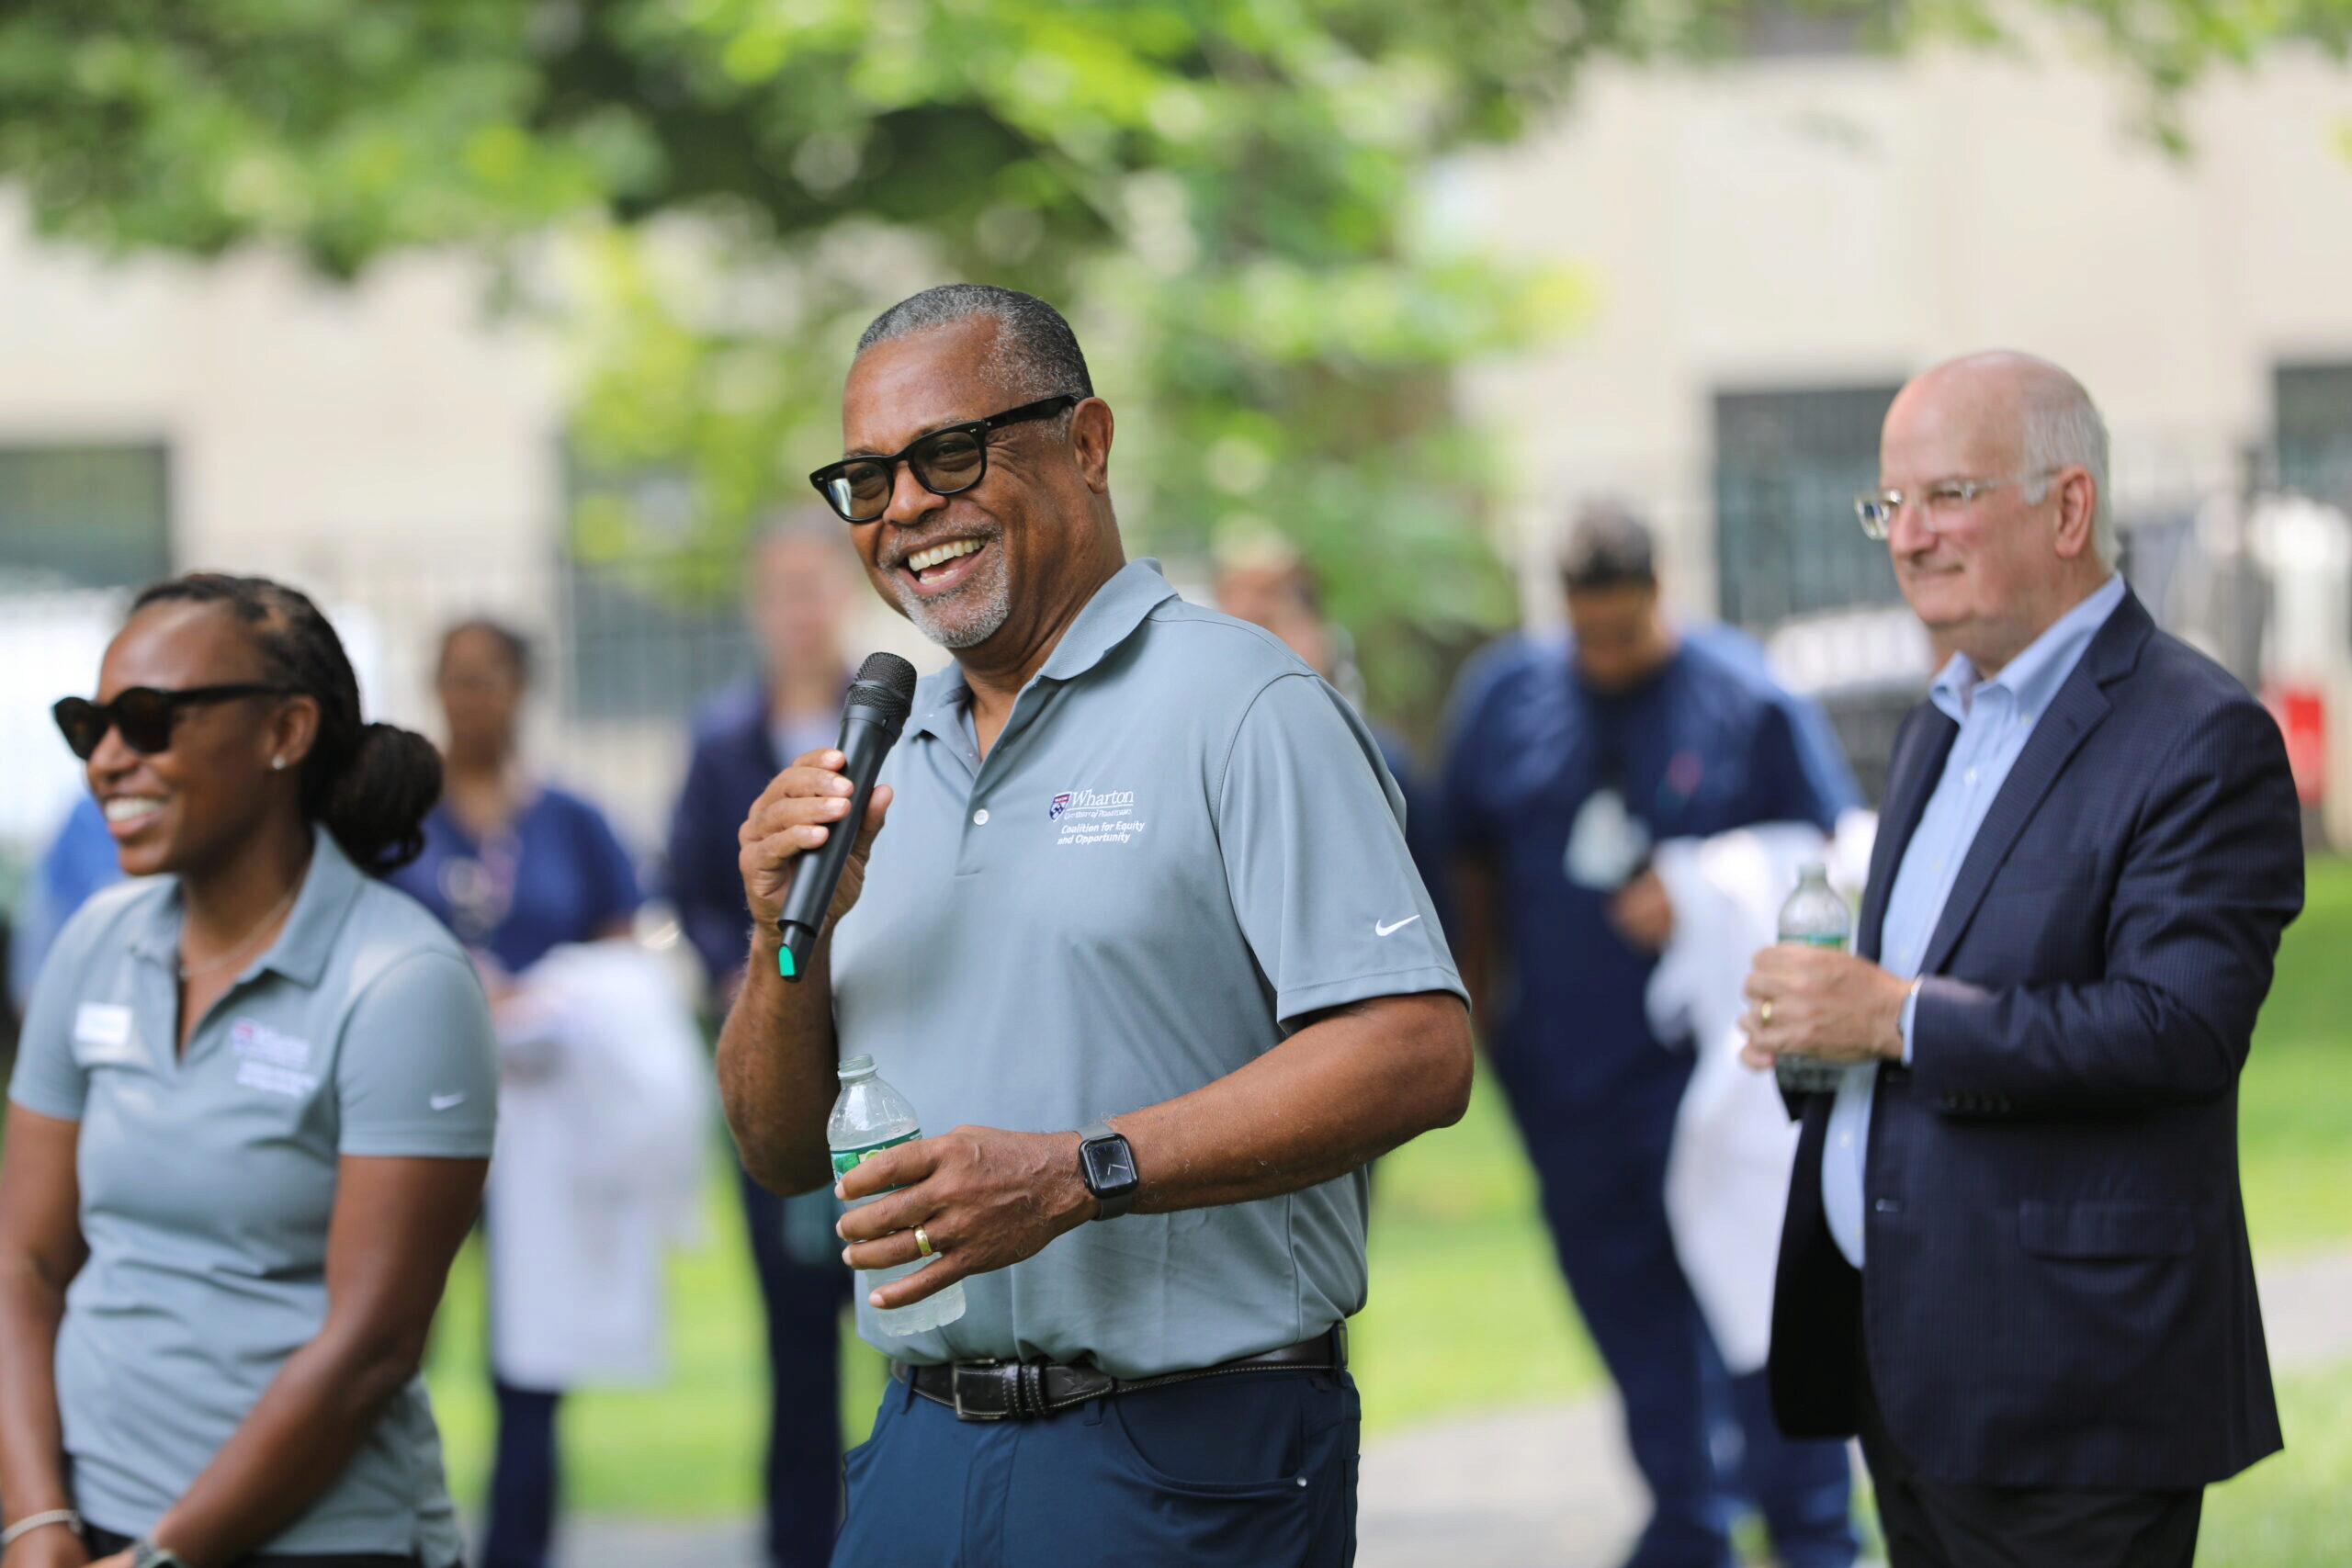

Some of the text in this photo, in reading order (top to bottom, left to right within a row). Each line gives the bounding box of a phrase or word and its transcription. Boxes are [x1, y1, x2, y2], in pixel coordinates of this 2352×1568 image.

[1071, 789, 1134, 807] Wharton
[1061, 820, 1146, 834] Coalition for Equity
[1057, 832, 1131, 845] and Opportunity
